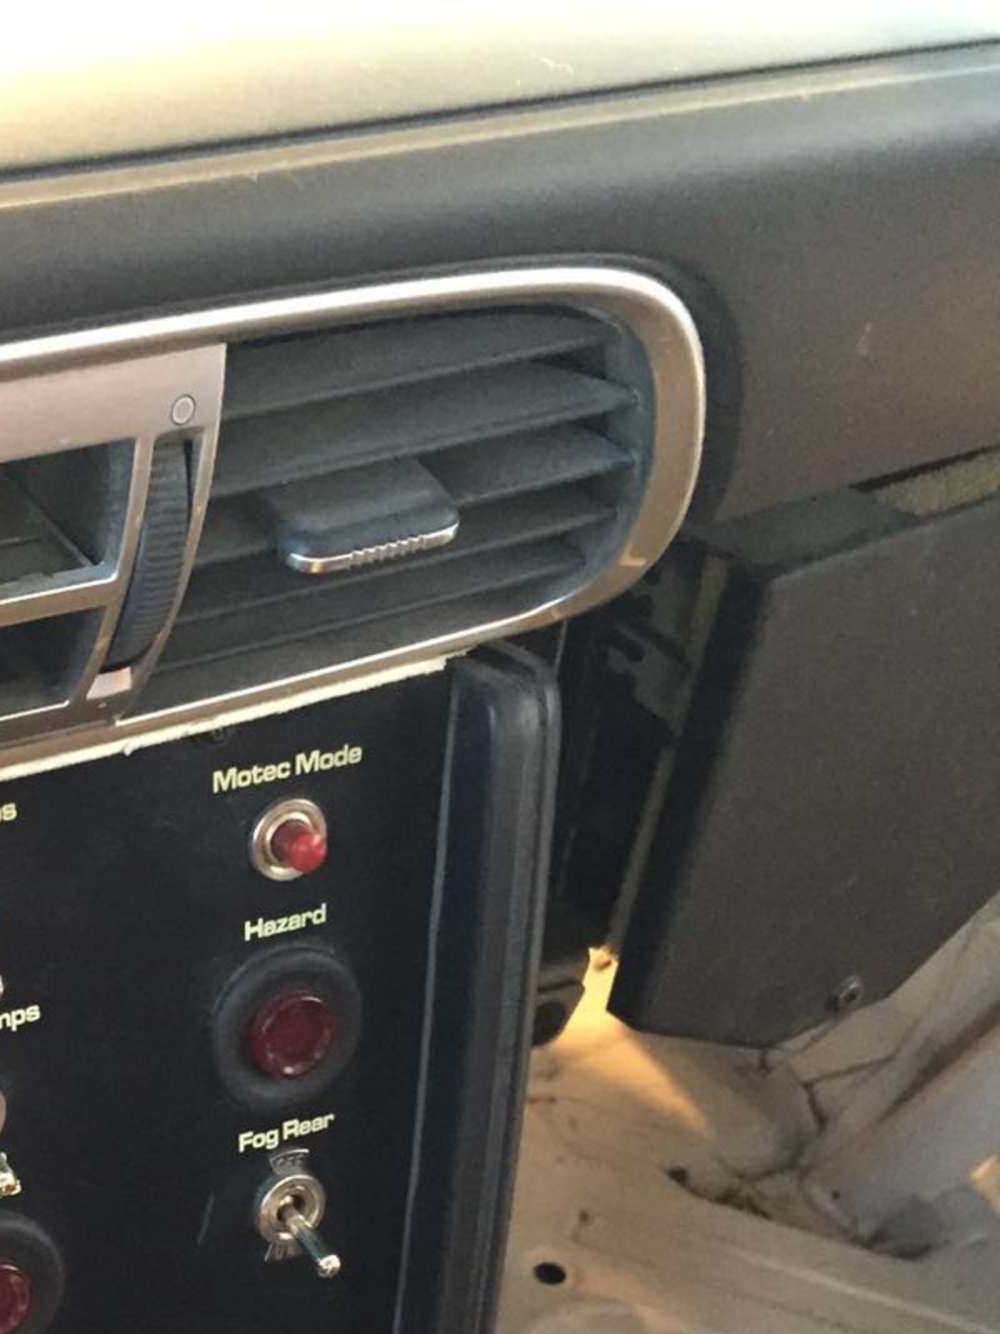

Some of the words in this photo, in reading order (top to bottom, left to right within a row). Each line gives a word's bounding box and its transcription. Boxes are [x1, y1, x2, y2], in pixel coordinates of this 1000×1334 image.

[212, 761, 292, 794] Motec
[295, 743, 363, 776] Mode
[244, 902, 327, 942] Hazard
[238, 1128, 280, 1153] Fog
[282, 1113, 335, 1141] Rear
